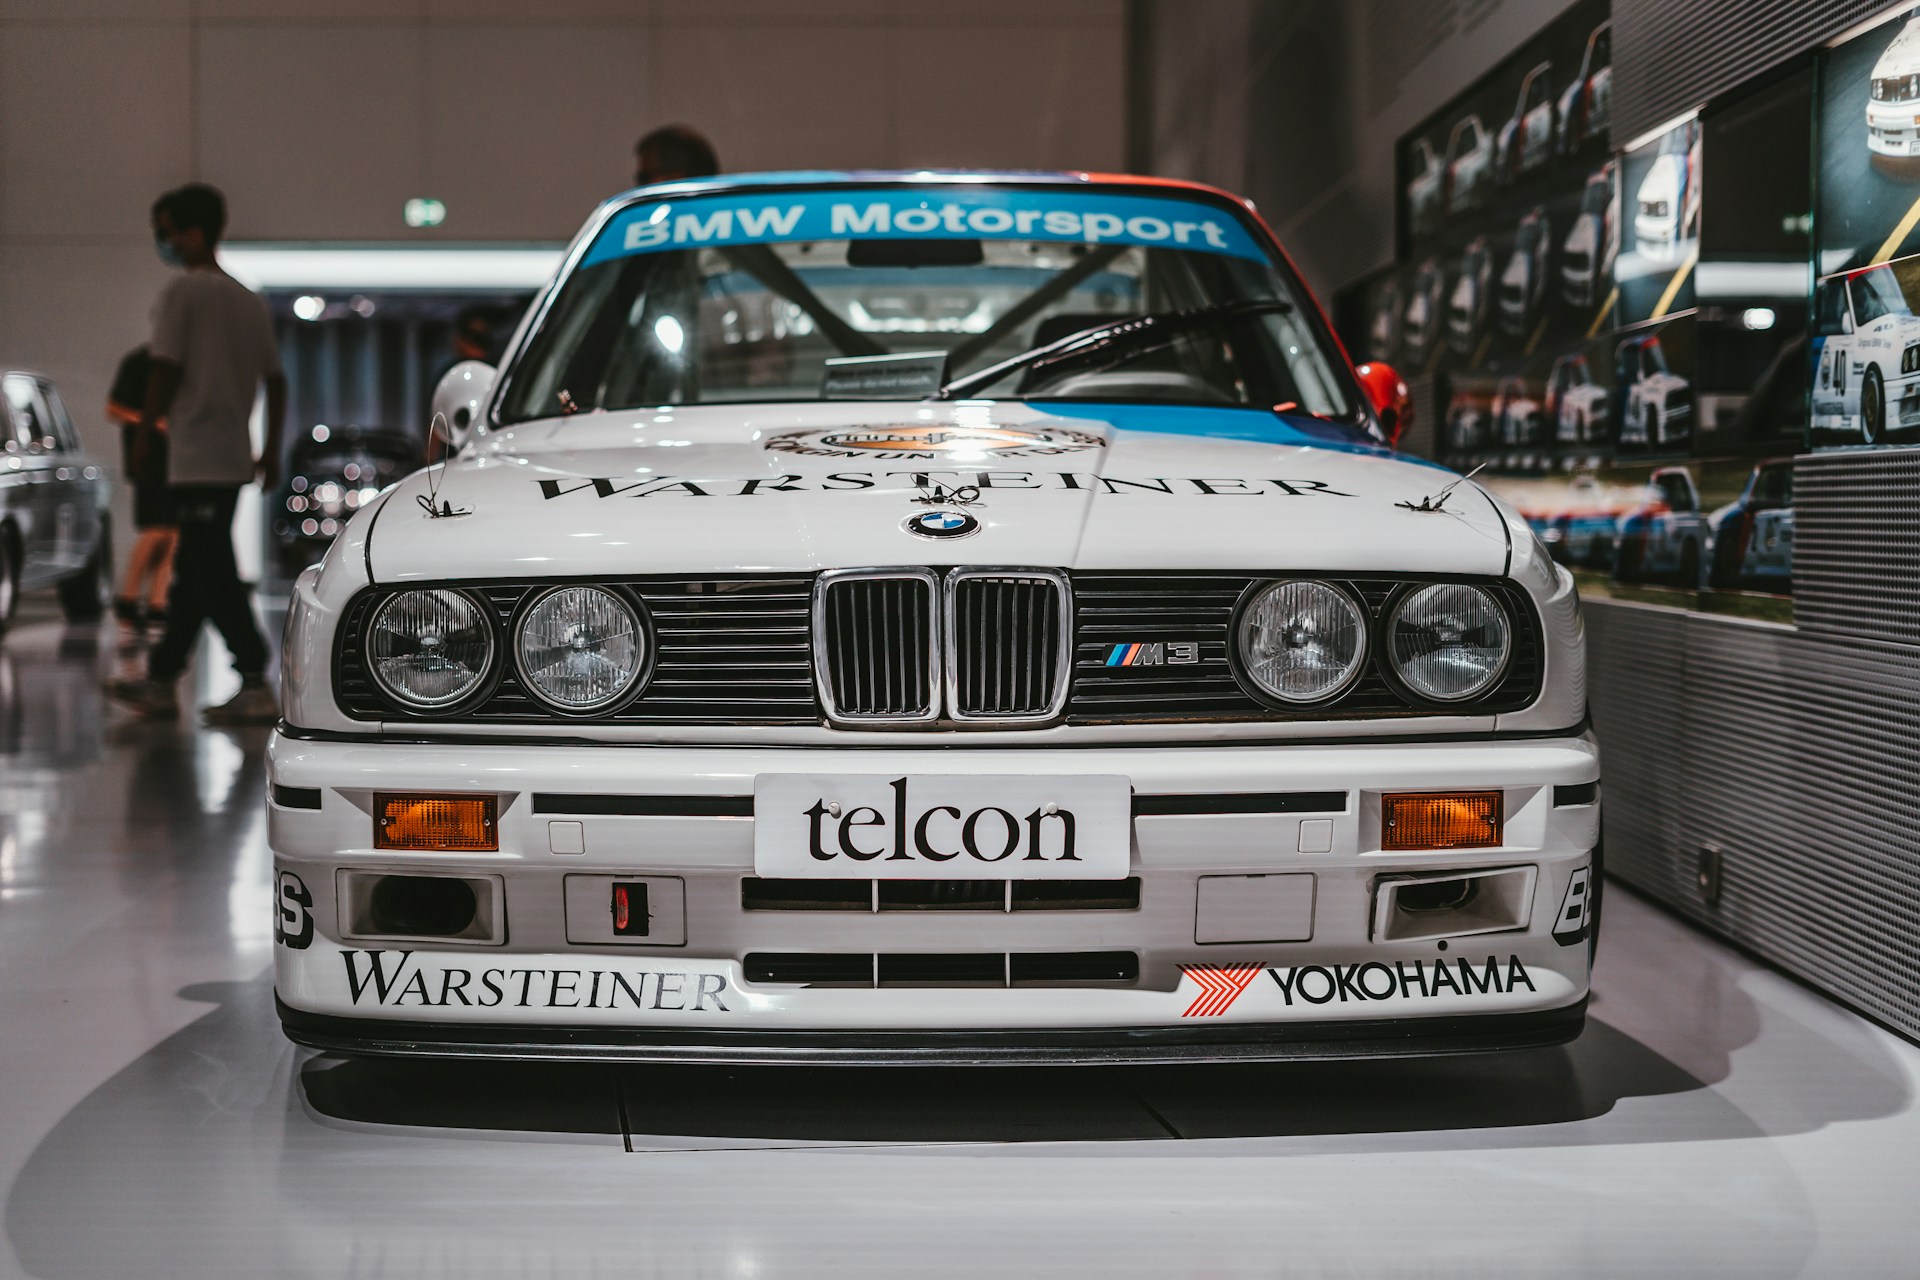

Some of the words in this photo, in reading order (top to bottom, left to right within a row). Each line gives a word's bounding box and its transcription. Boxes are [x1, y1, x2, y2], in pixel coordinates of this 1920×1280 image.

[623, 205, 806, 250] BMW
[831, 202, 1228, 249] Motorsport
[530, 472, 1360, 500] WARSTEINER
[803, 776, 1083, 861] telcon
[274, 866, 314, 950] S
[338, 950, 730, 1012] WARSTEINER
[1267, 954, 1537, 1006] YOKOHAMA
